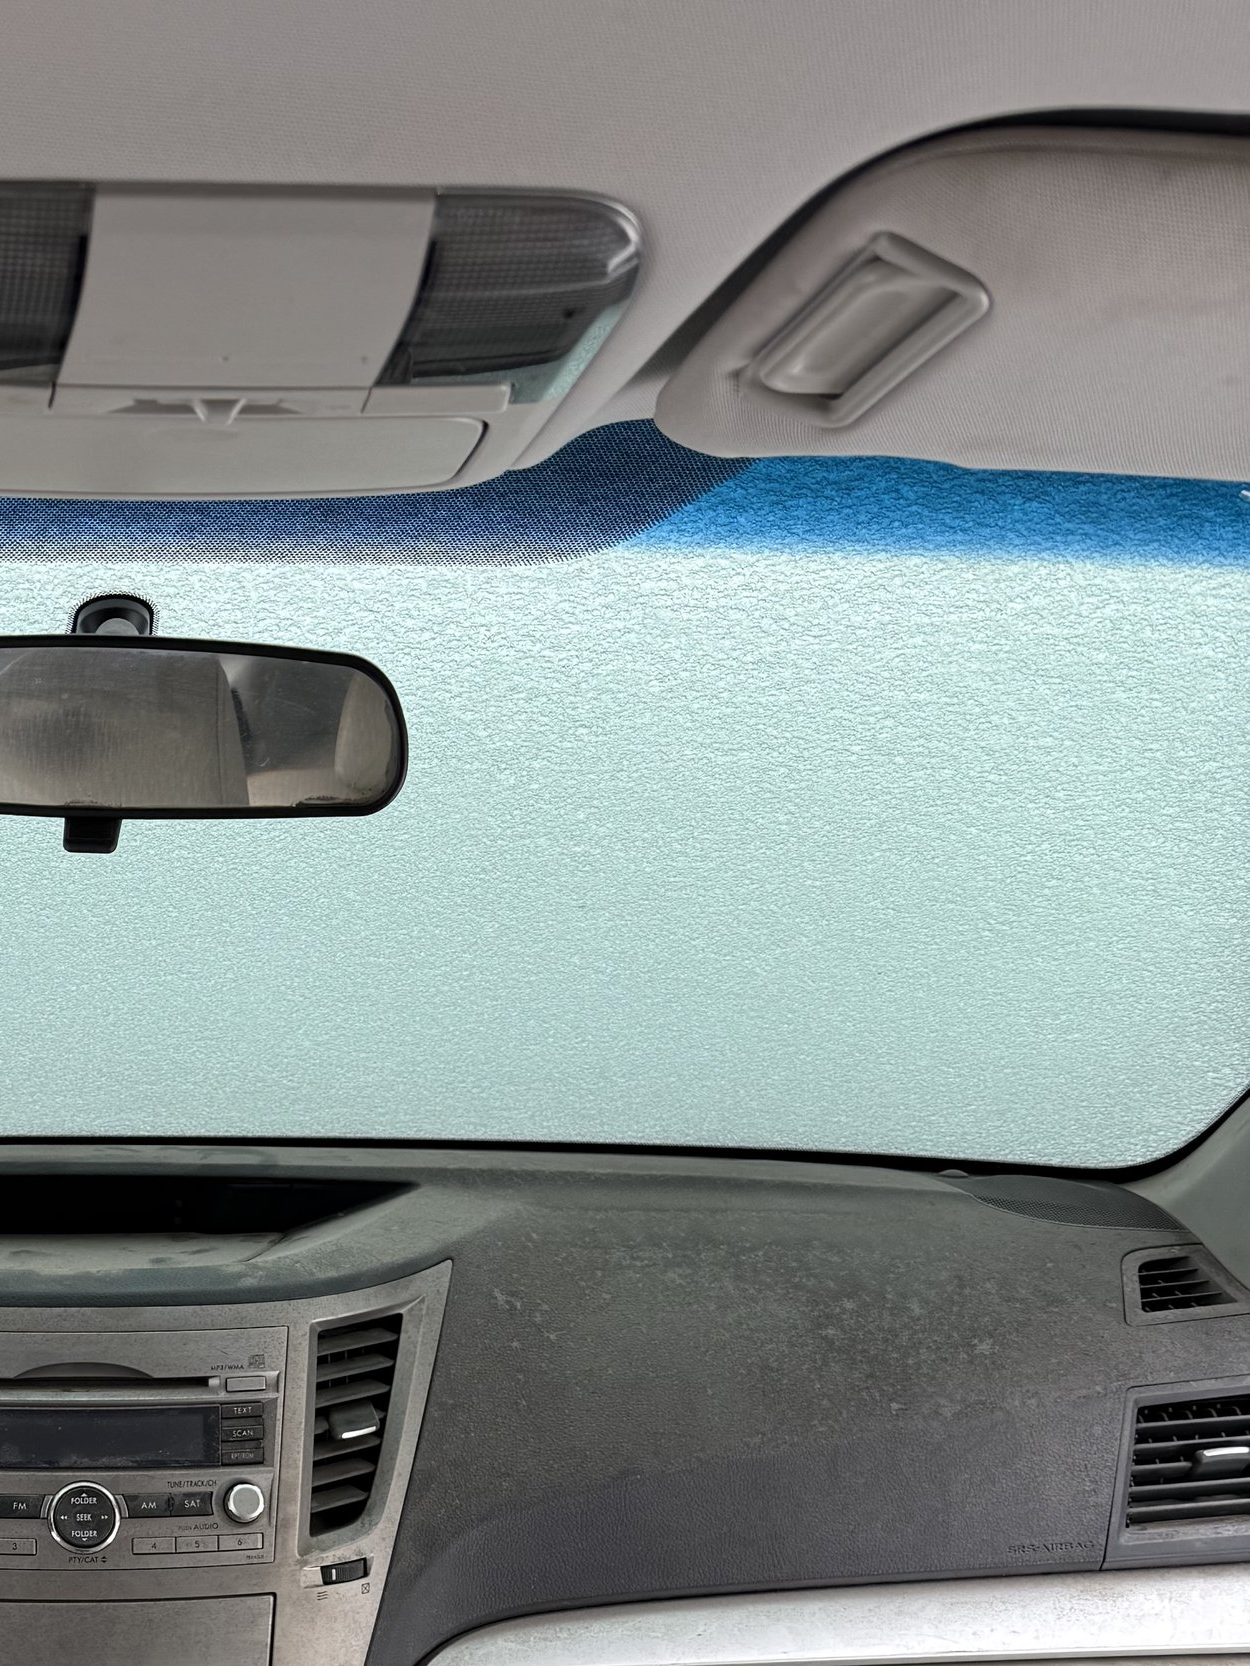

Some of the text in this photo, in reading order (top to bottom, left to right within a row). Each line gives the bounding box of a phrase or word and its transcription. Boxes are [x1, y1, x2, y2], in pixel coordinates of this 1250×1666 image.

[233, 1406, 252, 1414] TEXT
[232, 1430, 253, 1438] SCAN
[167, 1480, 217, 1489] TUNE/TRACK/CH
[13, 1502, 27, 1510] FM
[184, 1499, 201, 1508] SAT
[76, 1513, 92, 1521] SEEK
[151, 1542, 157, 1550] 4
[237, 1538, 243, 1546] 6
